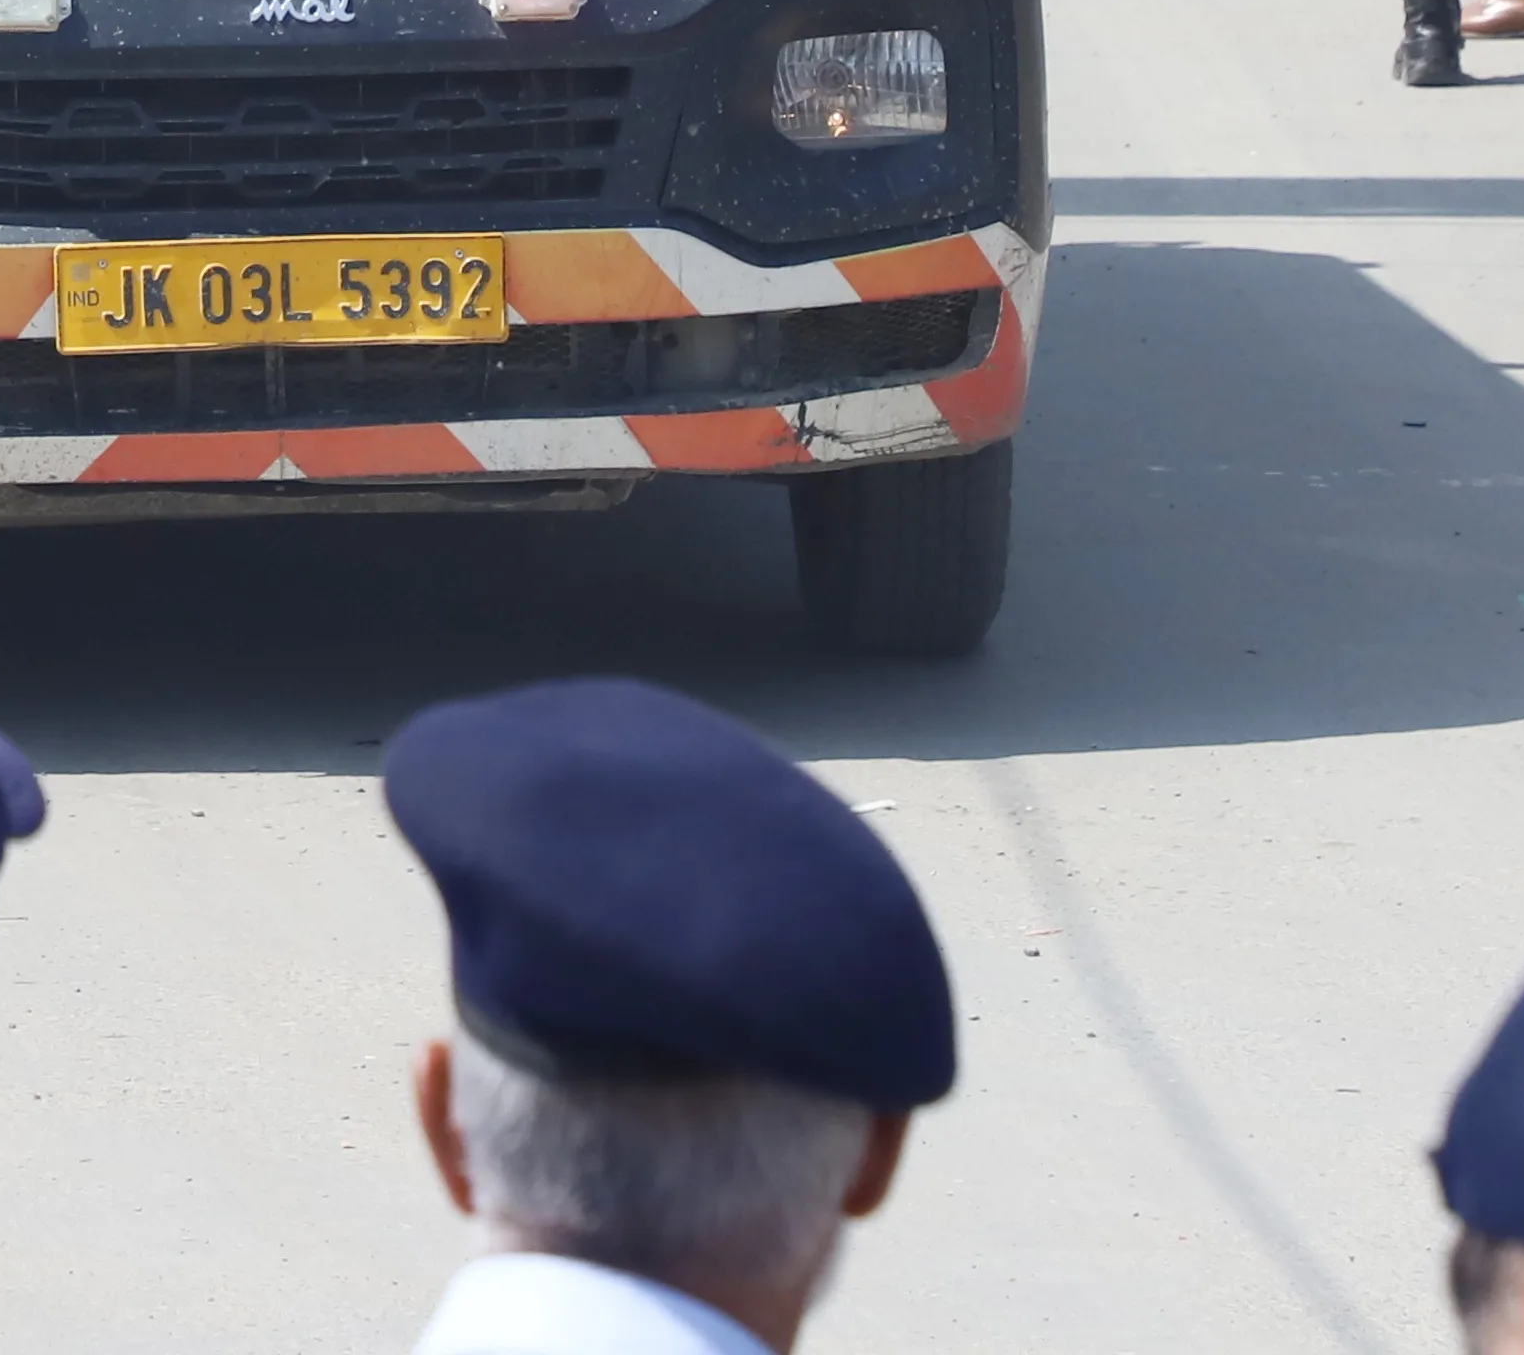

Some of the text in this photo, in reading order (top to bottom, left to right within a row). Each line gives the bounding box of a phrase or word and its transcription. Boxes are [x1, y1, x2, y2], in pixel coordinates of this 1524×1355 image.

[67, 289, 100, 308] IND
[101, 257, 494, 330] JK 03L 5392
